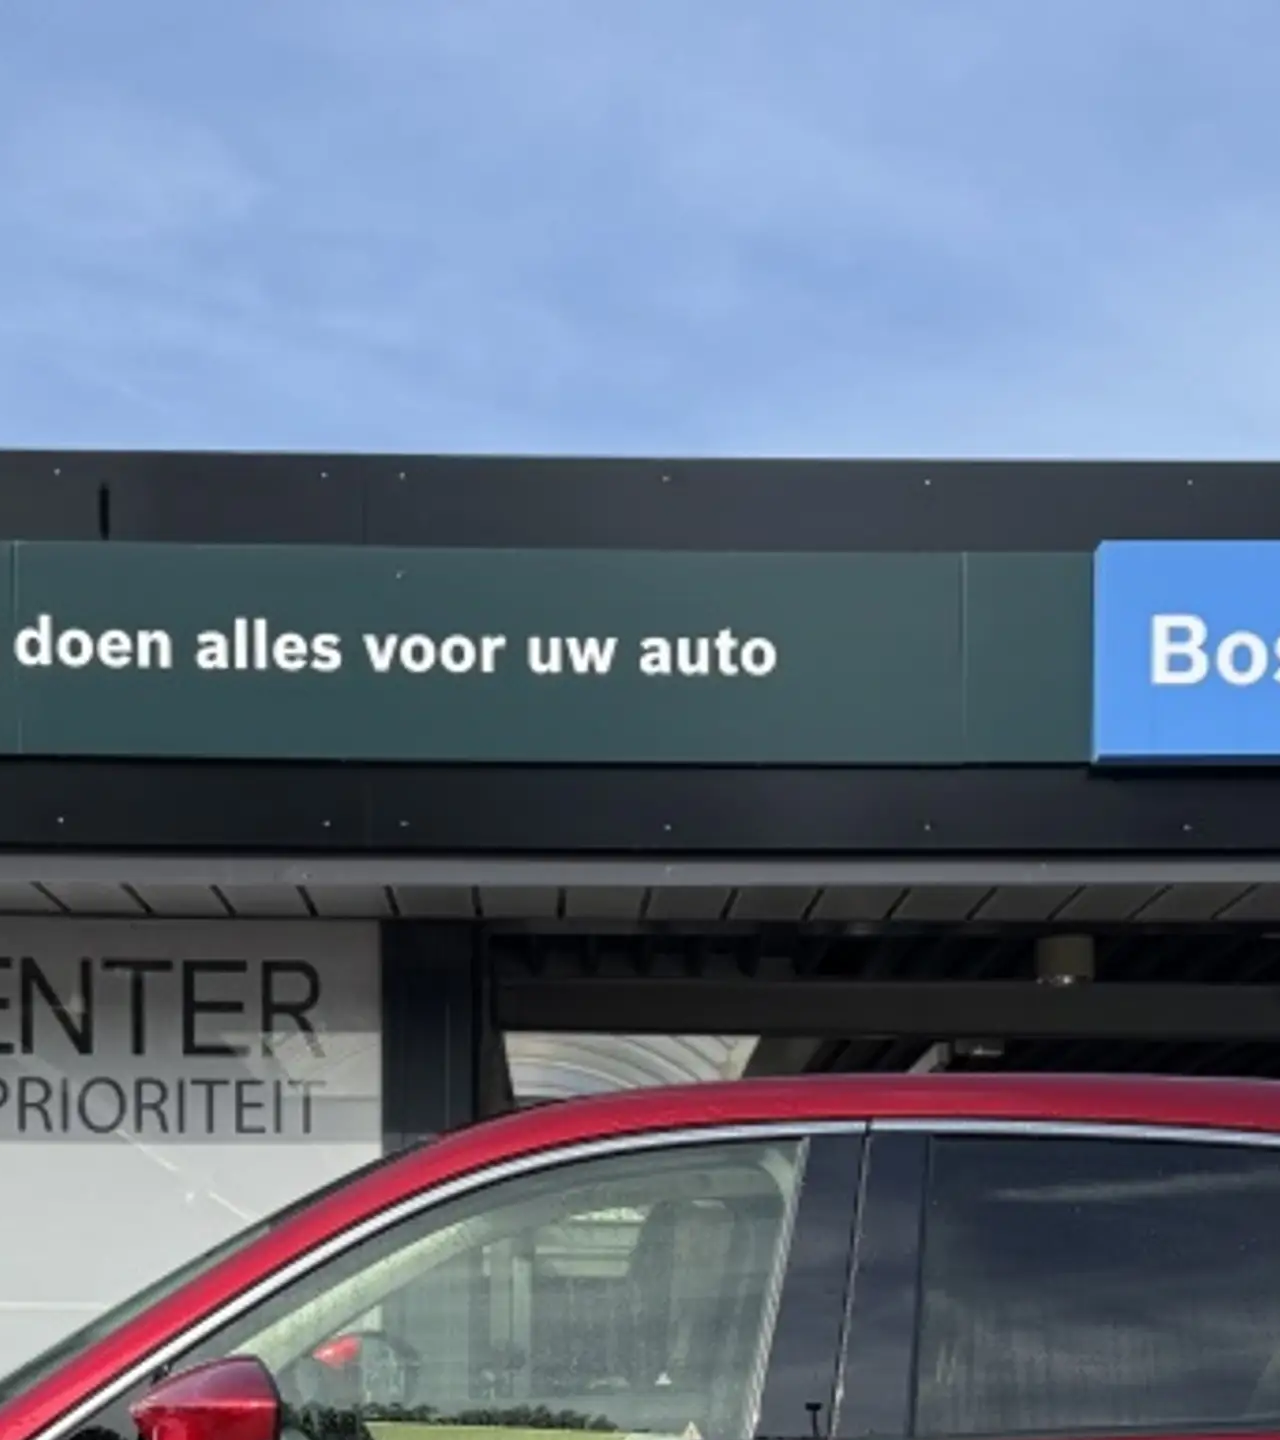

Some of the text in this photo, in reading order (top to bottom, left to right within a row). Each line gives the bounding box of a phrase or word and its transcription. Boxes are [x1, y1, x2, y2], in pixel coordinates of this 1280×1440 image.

[14, 613, 173, 669] doen
[196, 617, 343, 673] alles
[362, 632, 507, 674] voor
[526, 636, 619, 675] uw
[639, 627, 778, 676] auto
